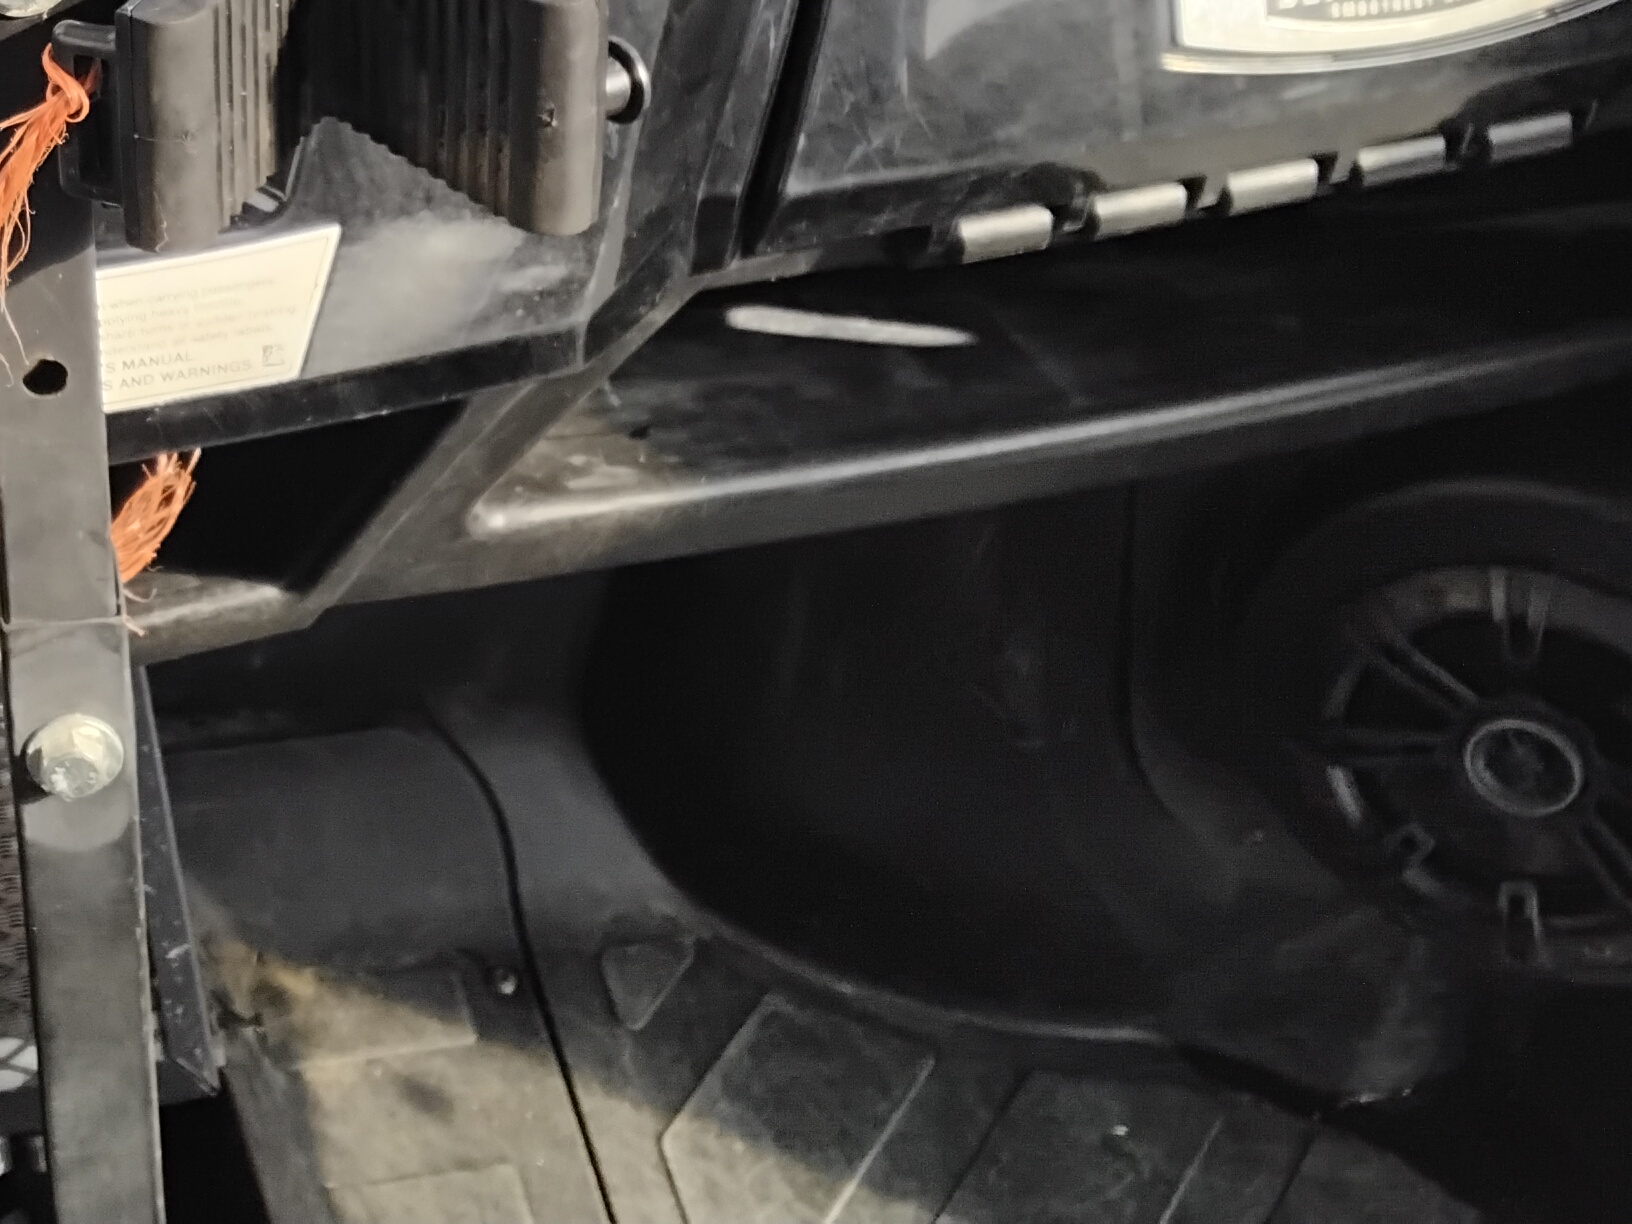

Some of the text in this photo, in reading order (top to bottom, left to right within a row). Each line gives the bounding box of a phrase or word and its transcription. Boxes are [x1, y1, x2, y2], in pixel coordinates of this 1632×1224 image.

[122, 350, 195, 371] MANUAL
[120, 373, 155, 389] AND
[160, 359, 253, 383] WARNINGS
